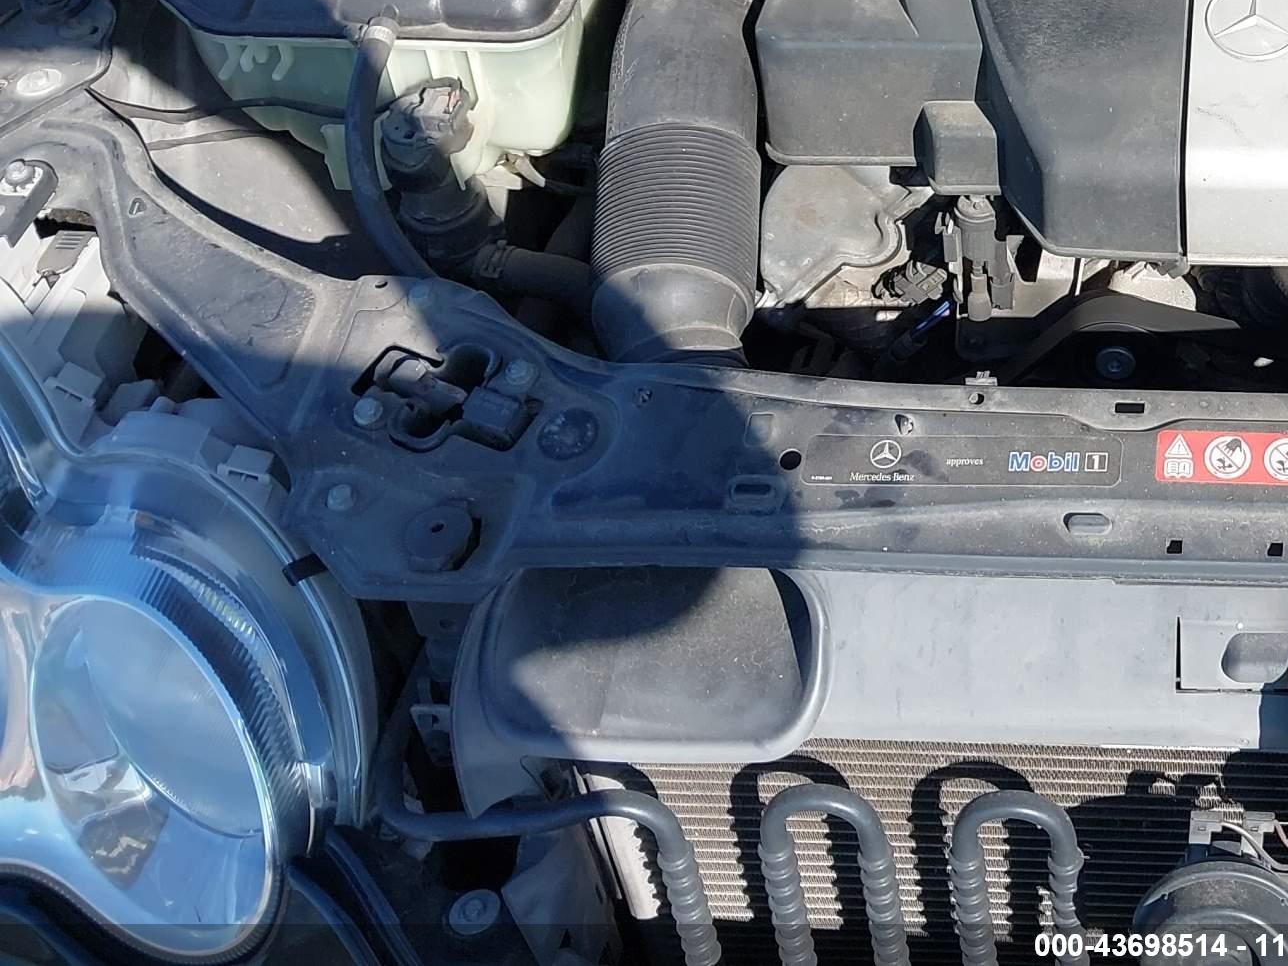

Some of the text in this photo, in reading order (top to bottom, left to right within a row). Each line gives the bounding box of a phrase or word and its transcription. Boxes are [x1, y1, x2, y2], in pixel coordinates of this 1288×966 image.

[946, 457, 984, 466] approves
[1008, 451, 1081, 472] Mobil
[850, 472, 915, 482] Mercedes Benz
